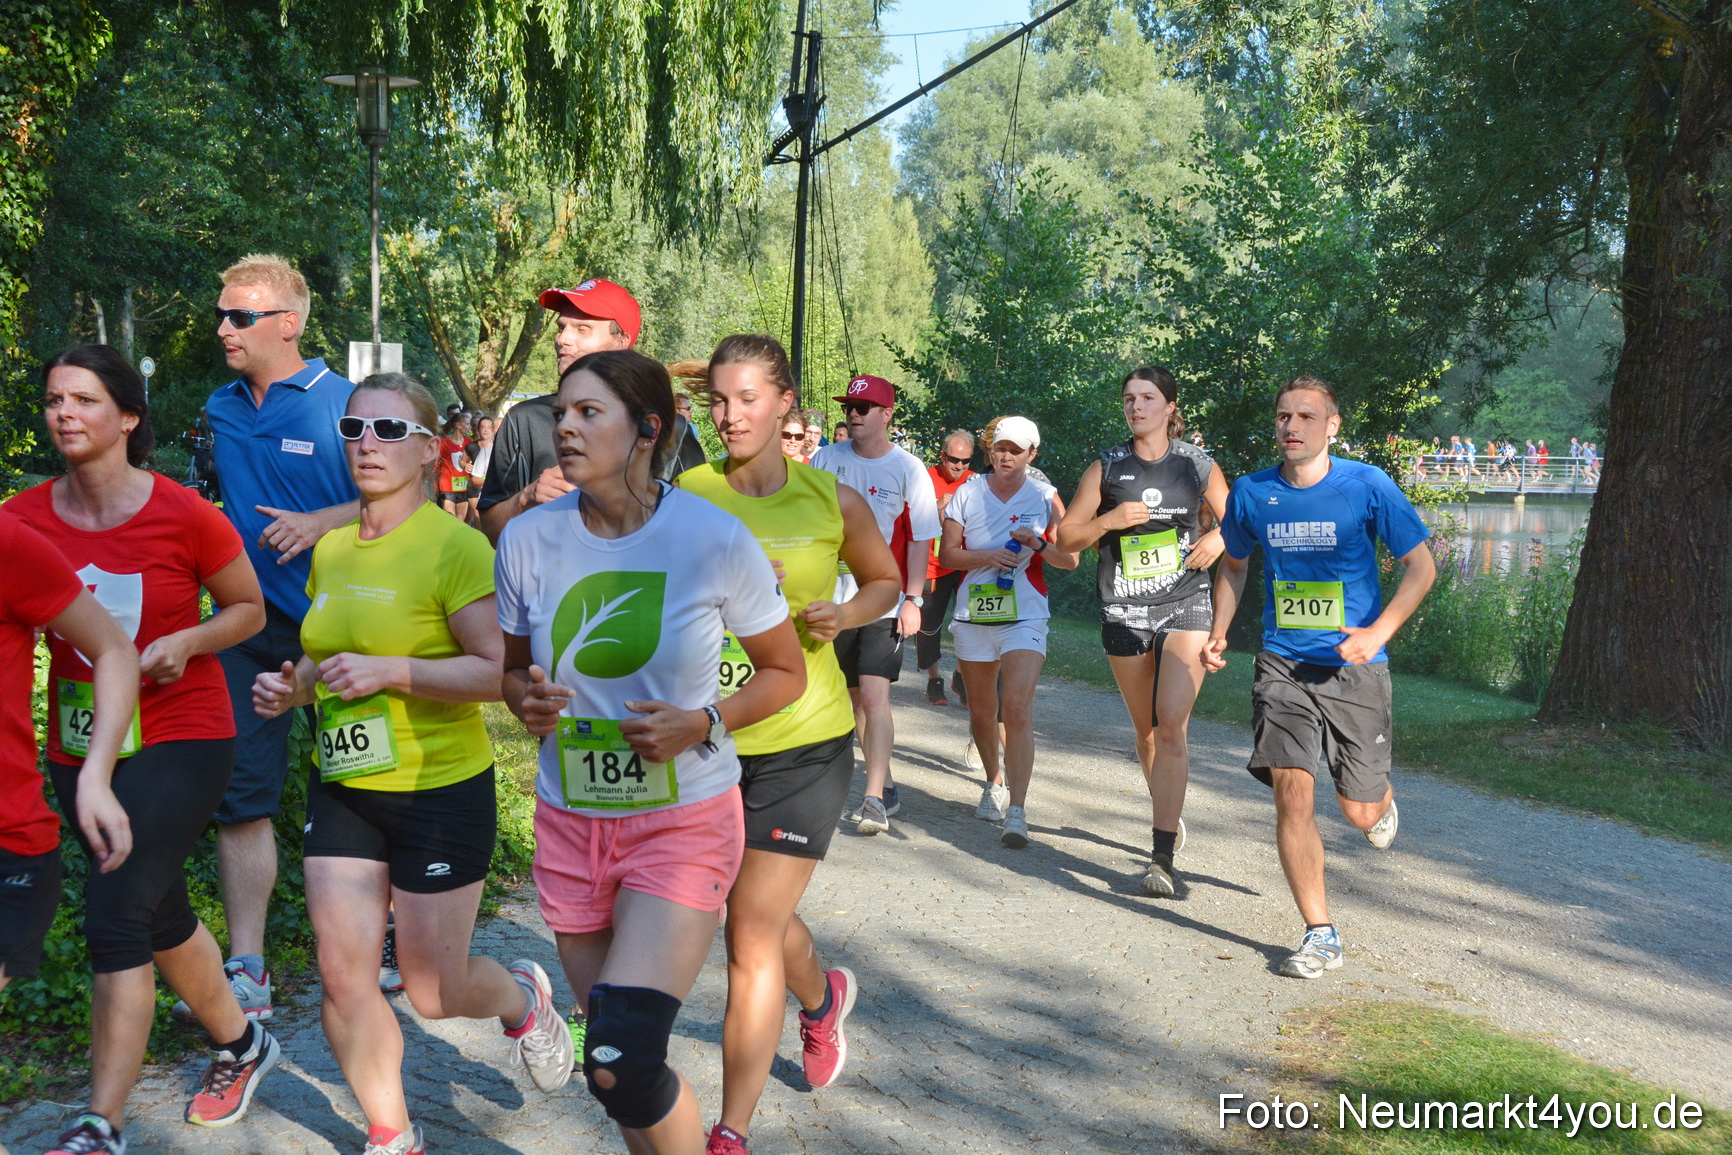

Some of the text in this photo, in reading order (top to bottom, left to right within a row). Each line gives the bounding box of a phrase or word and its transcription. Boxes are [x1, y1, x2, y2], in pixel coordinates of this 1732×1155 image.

[1266, 521, 1337, 539] HUBER
[1139, 548, 1160, 566] 81
[976, 596, 1004, 612] 257
[1282, 598, 1334, 616] 2107
[719, 661, 752, 688] 92
[69, 707, 95, 737] 42
[322, 723, 370, 759] 946
[340, 752, 375, 765] Roswitha
[582, 750, 647, 784] 184
[584, 784, 648, 794] Lehmann Julia
[596, 794, 635, 802] Bionorica SE
[775, 830, 808, 845] erima
